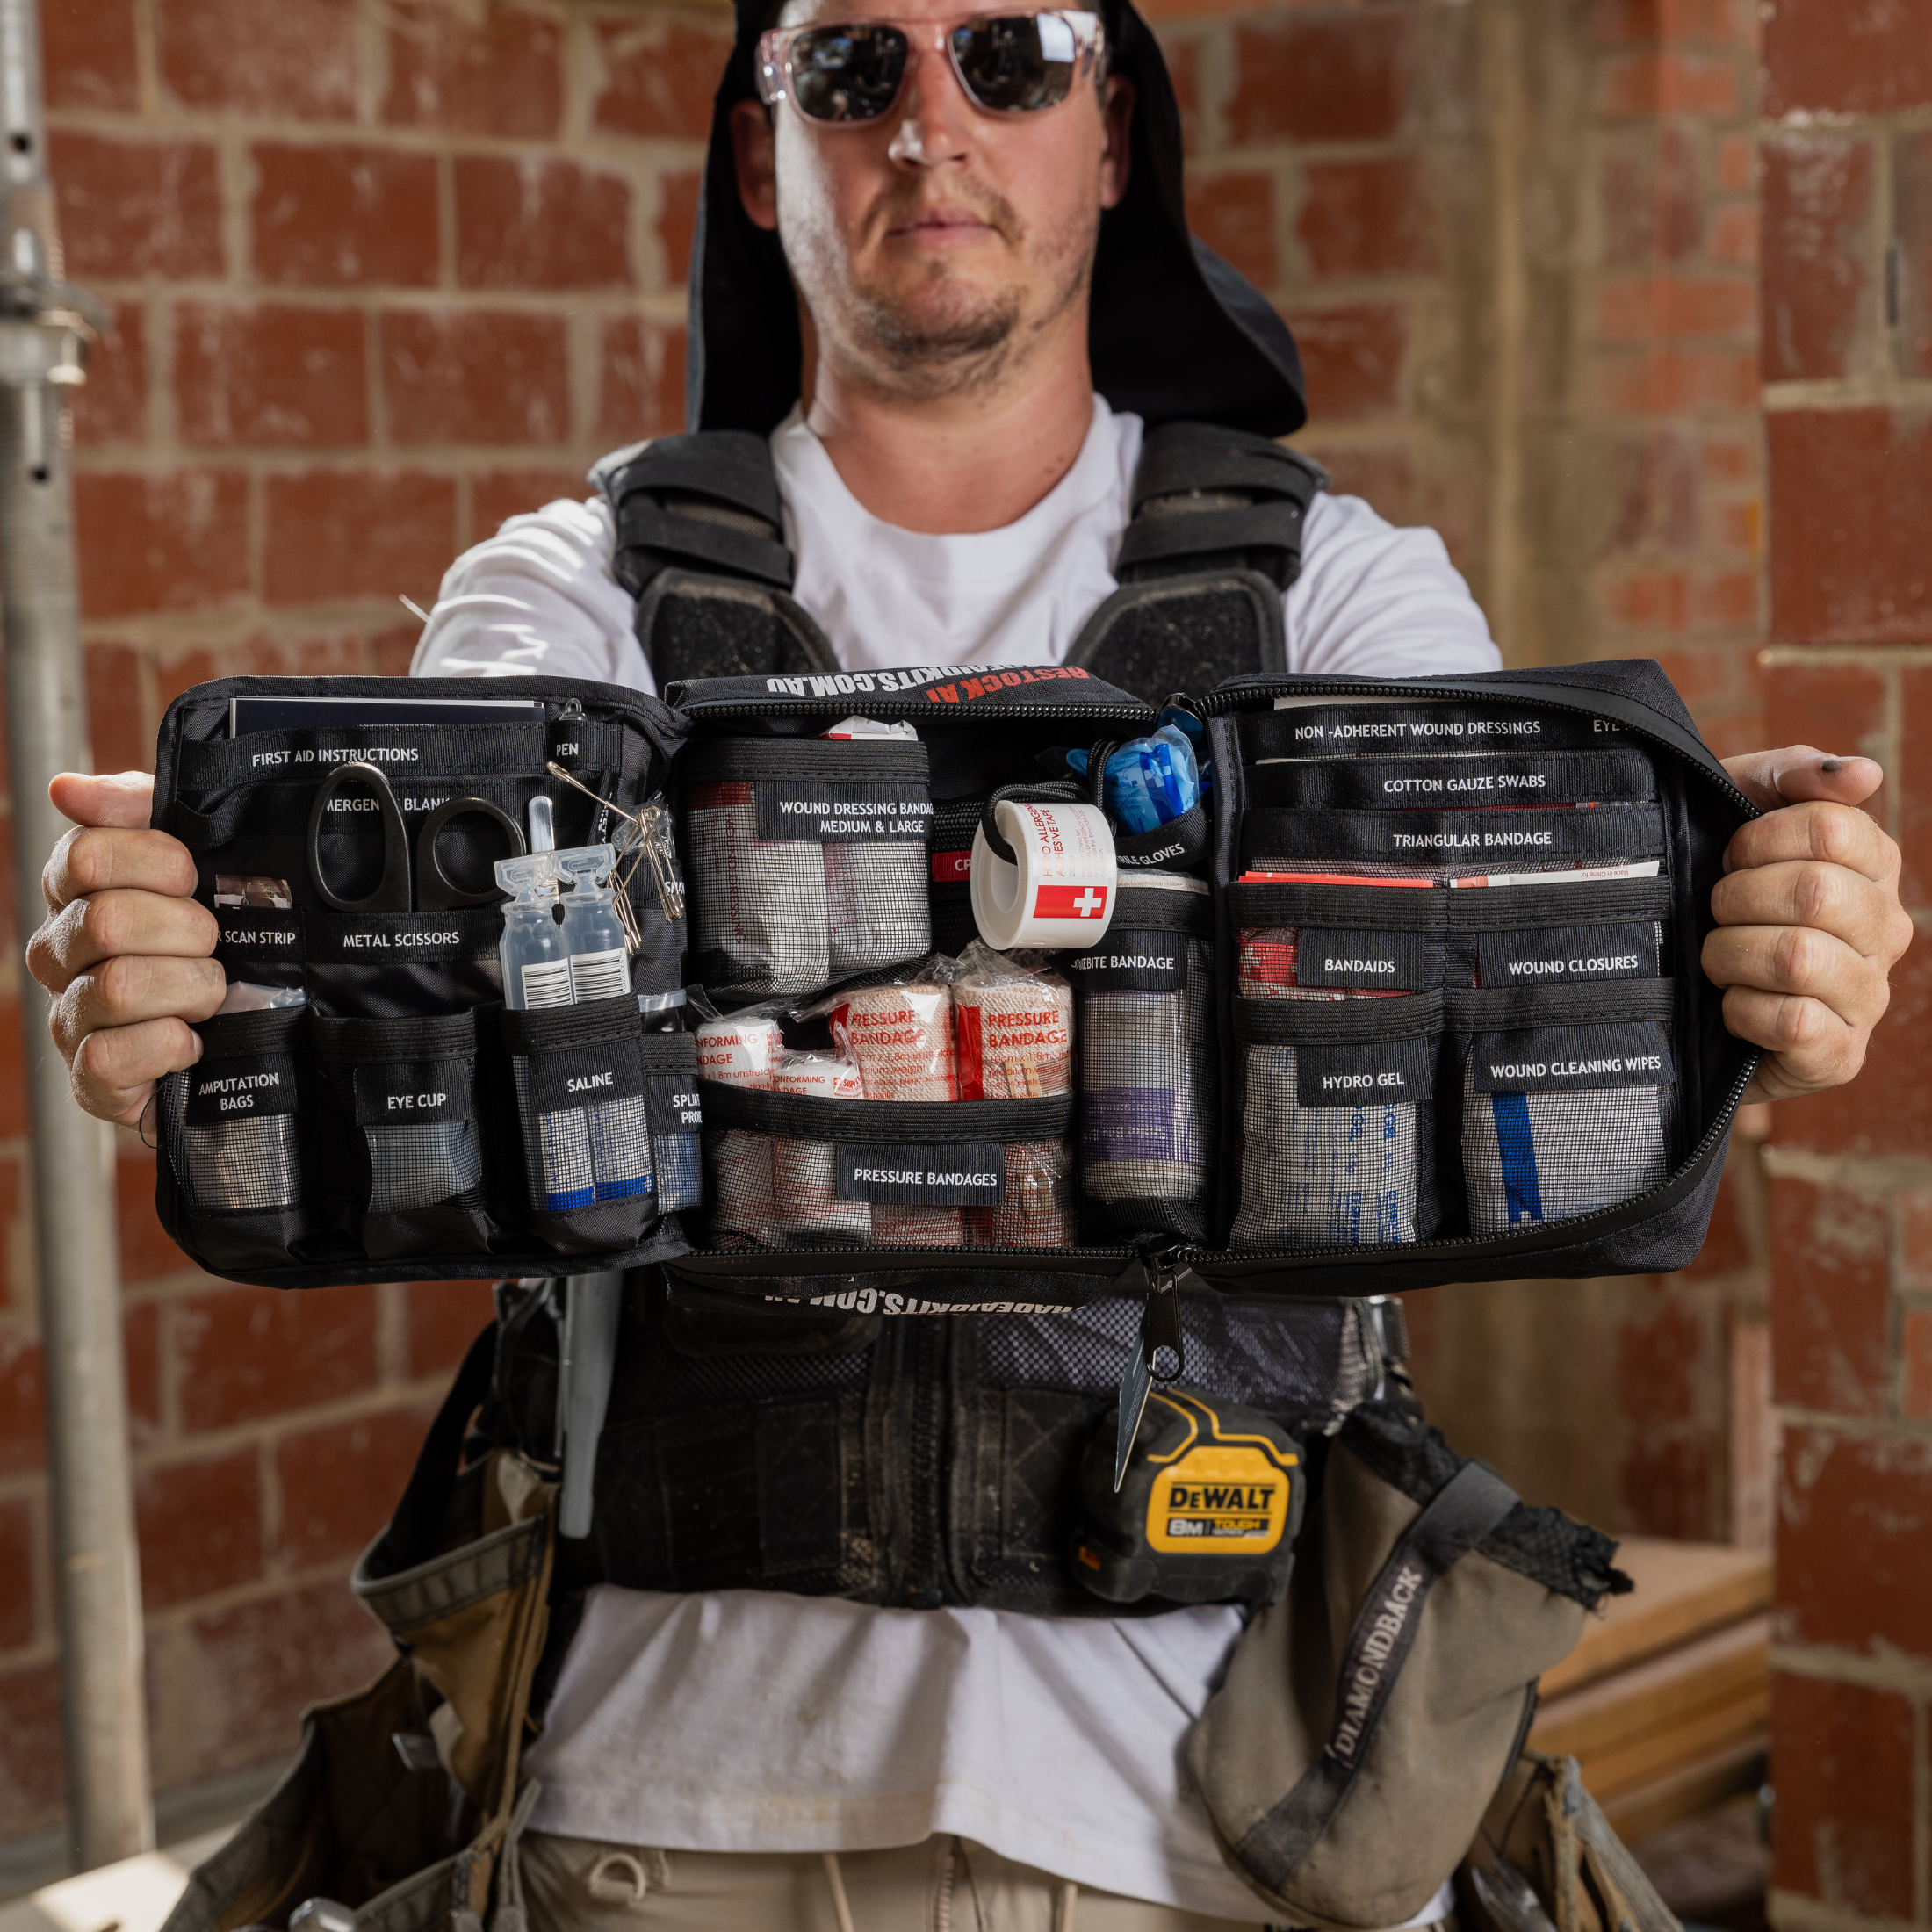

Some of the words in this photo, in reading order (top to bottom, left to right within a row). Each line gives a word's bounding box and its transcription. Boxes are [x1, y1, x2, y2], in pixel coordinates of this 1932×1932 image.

[960, 667, 1090, 701] RESTOCK
[1295, 725, 1323, 739] NON
[1410, 723, 1464, 736] WOUND
[1468, 721, 1541, 735] DRESSINGS
[252, 751, 291, 767] FIRST
[294, 750, 314, 762] AID
[319, 748, 419, 762] INSTRUCTIONS
[556, 743, 579, 756] PEN
[1384, 779, 1443, 792] COTTON
[1447, 776, 1494, 791] GAUZE
[1498, 775, 1546, 788] SWABS
[779, 801, 831, 815] WOUND
[834, 803, 897, 815] DRESSING
[1040, 809, 1056, 825] TAPE
[819, 821, 871, 833] MEDIUM
[875, 821, 885, 833] &
[890, 821, 925, 833] LARGE
[1393, 834, 1480, 847] TRIANGULAR
[1484, 832, 1552, 846] BANDAGE
[1049, 827, 1065, 877] ADHESIVE
[1139, 843, 1186, 865] GLOVES
[955, 859, 970, 871] CP
[1042, 846, 1053, 877] HYPO
[225, 931, 256, 943] SCAN
[260, 932, 296, 945] STRIP
[343, 934, 390, 948] METAL
[395, 932, 460, 947] SCISSORS
[1110, 955, 1174, 970] BANDAGE
[1324, 959, 1395, 973] BANDAIDS
[1508, 960, 1565, 975] WOUND
[1569, 955, 1638, 972] CLOSURES
[851, 1010, 916, 1027] PRESSURE
[988, 1010, 1059, 1027] PRESSURE
[696, 1034, 758, 1048] NFORMING
[850, 1029, 925, 1045] BANDAGE
[989, 1029, 1067, 1047] BANDAGE
[696, 1053, 733, 1065] NDAGE
[1490, 1063, 1545, 1078] WOUND
[1551, 1058, 1622, 1077] CLEANING
[1625, 1056, 1662, 1071] WIPES
[861, 1065, 890, 1074] edium
[892, 1063, 926, 1074] weight
[990, 1065, 1032, 1077] Medium
[198, 1072, 279, 1096] AMPUTATION
[567, 1071, 613, 1092] SALINE
[1323, 1074, 1373, 1090] HYDRO
[1377, 1072, 1404, 1086] GEL
[220, 1094, 254, 1111] BAGS
[387, 1095, 414, 1110] EYE
[417, 1092, 447, 1107] CUP
[854, 1168, 923, 1185] PRESSURE
[926, 1172, 998, 1186] BANDAGES
[1169, 1518, 1204, 1536] 8M
[1334, 1563, 1424, 1757] DIAMONDBACK
